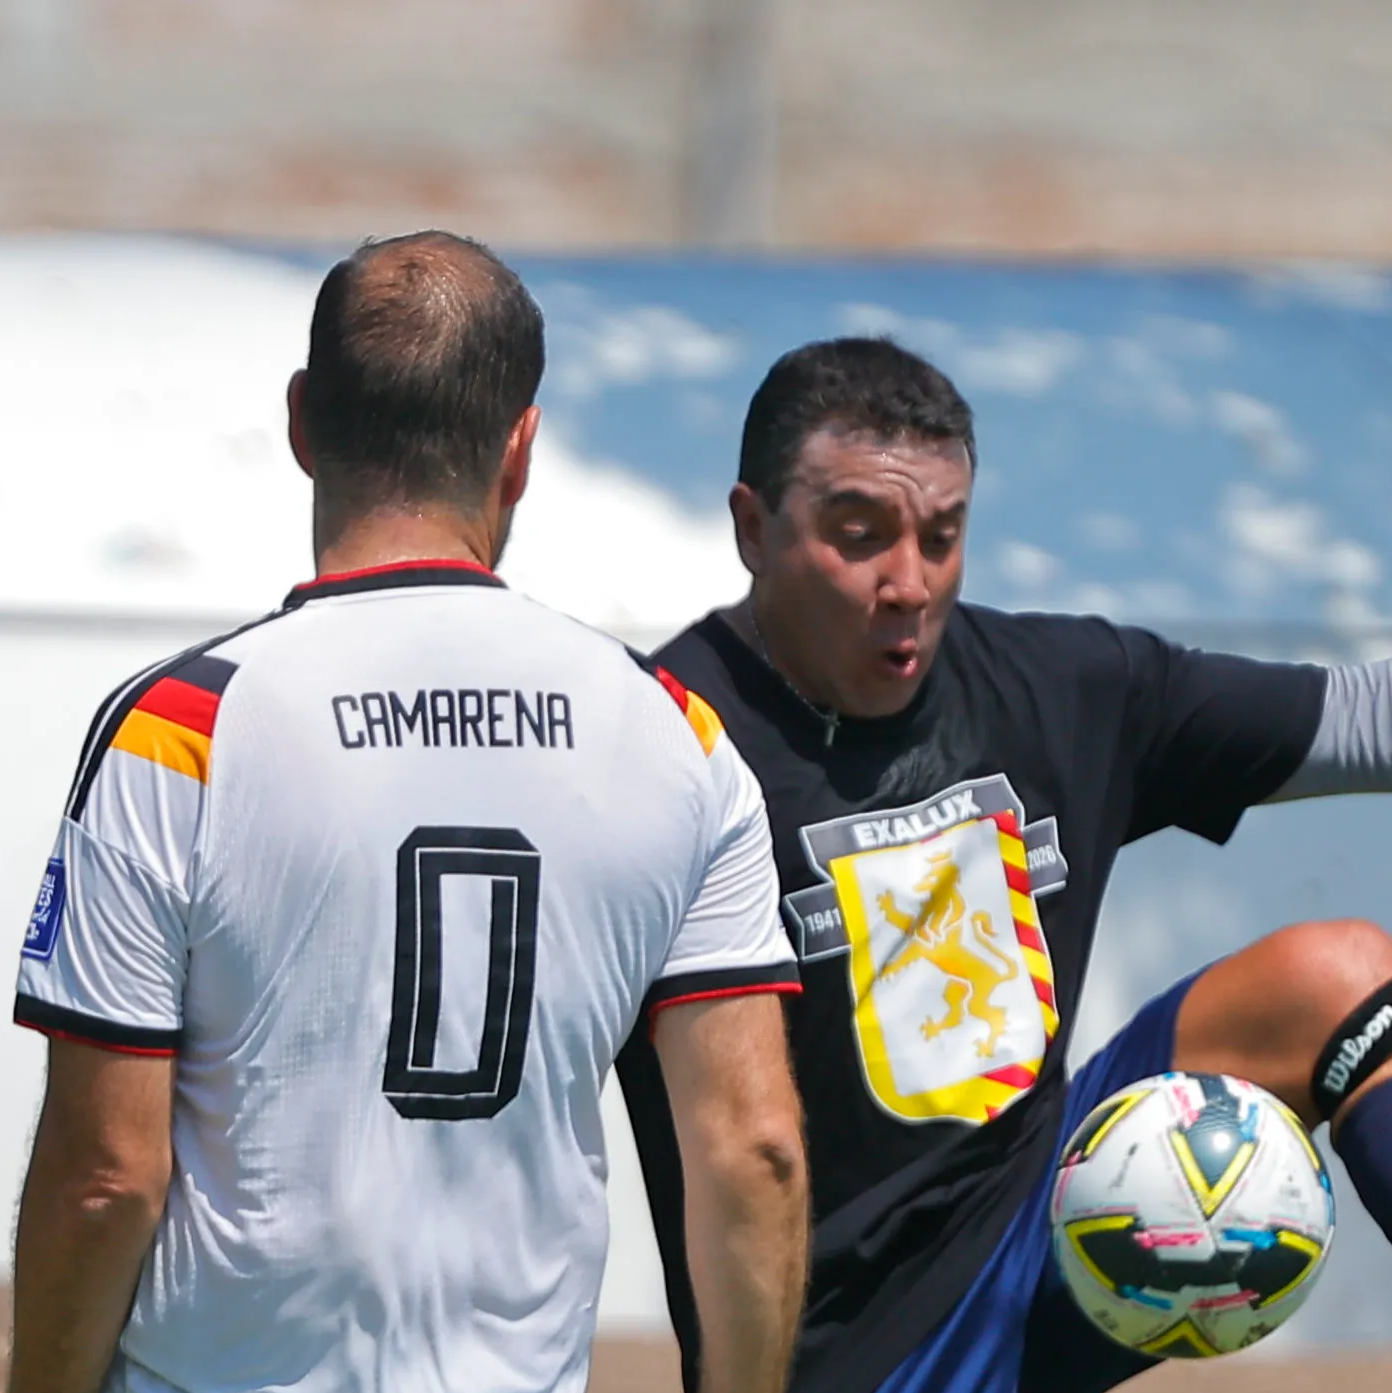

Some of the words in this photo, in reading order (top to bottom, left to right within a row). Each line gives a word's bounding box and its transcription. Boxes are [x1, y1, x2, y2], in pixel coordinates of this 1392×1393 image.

[332, 689, 575, 750] CAMARENA
[853, 789, 982, 848] EXALUX
[804, 907, 842, 936] 1941
[383, 826, 541, 1119] 0
